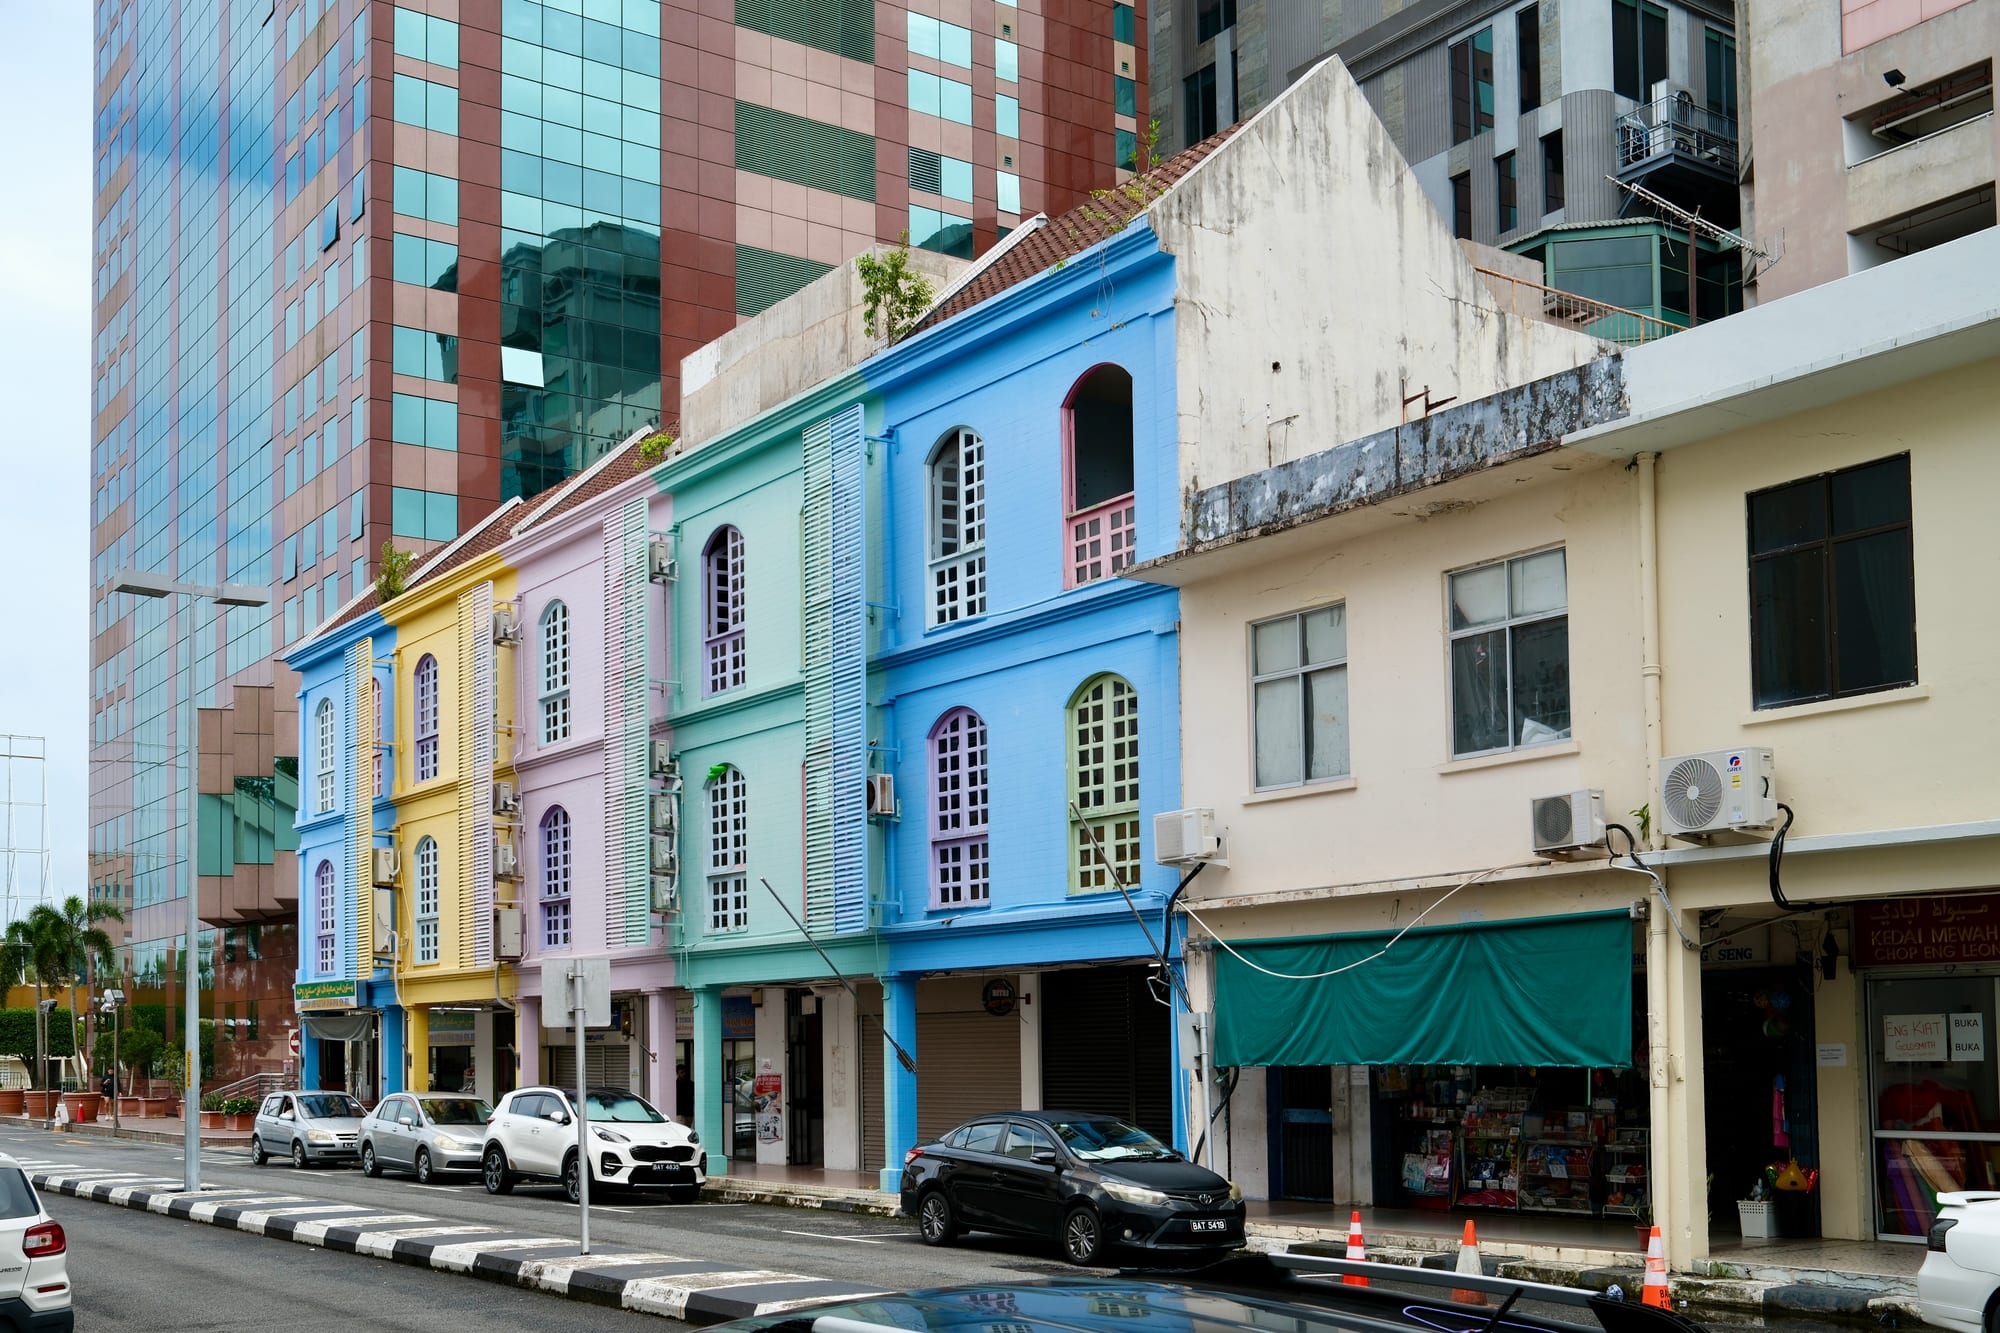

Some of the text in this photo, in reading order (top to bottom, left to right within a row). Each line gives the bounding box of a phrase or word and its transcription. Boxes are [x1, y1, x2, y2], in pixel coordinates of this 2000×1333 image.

[1872, 923, 1999, 946] KEDAI MEWAH
[1718, 948, 1752, 961] SENG
[1874, 946, 1918, 961] CHOP
[1924, 945, 1957, 959] ENG
[1954, 1019, 1979, 1028] BUKA
[1955, 1043, 1980, 1052] BUKA
[1193, 1221, 1224, 1230] BAT 5419
